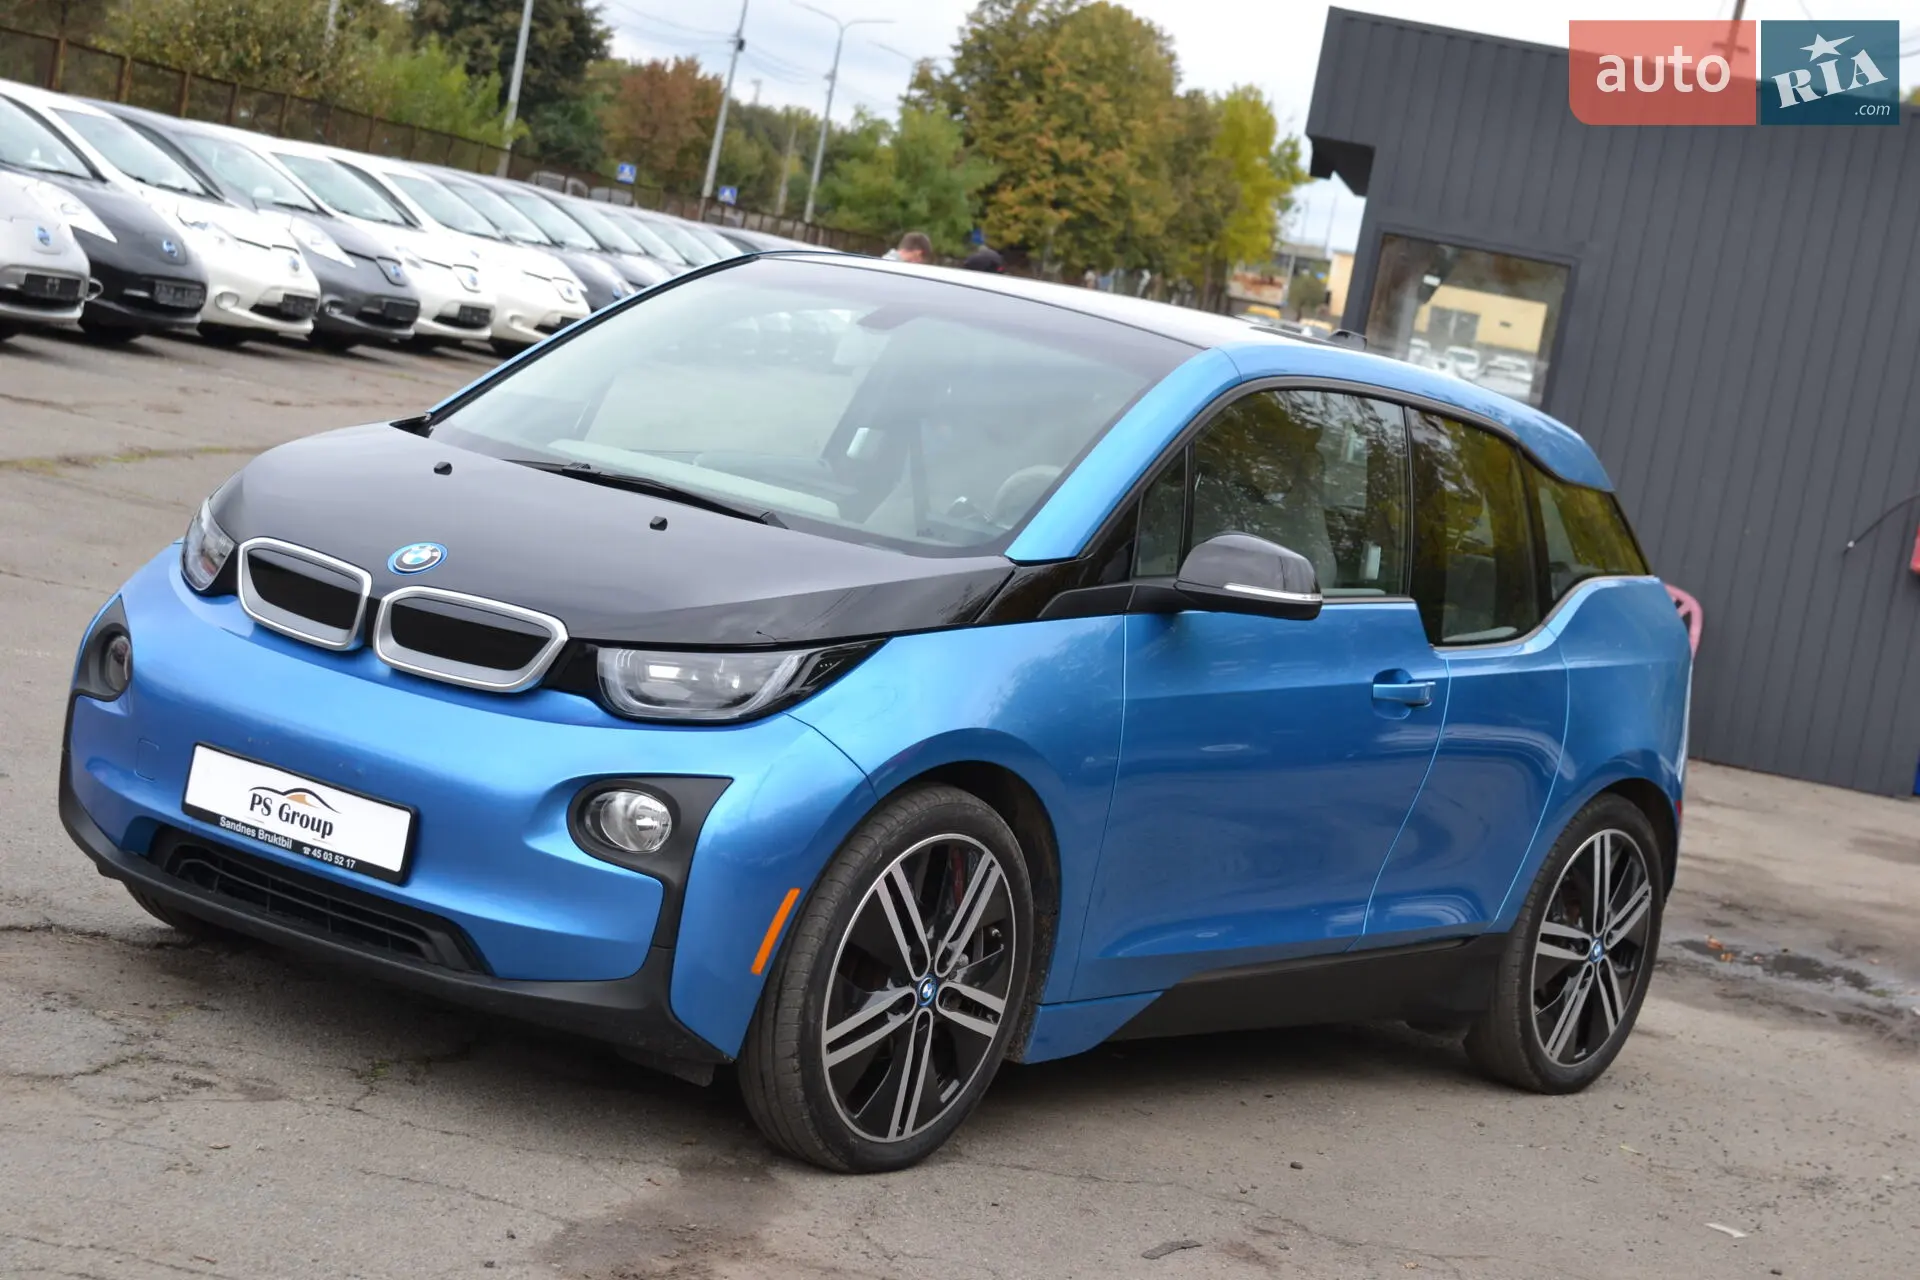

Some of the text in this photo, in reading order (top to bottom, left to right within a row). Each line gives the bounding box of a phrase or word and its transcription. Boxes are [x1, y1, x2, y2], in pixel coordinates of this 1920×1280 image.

[249, 793, 334, 839] PS Group
[219, 816, 356, 870] Sandnes Bruktbil 45 03 52 17
